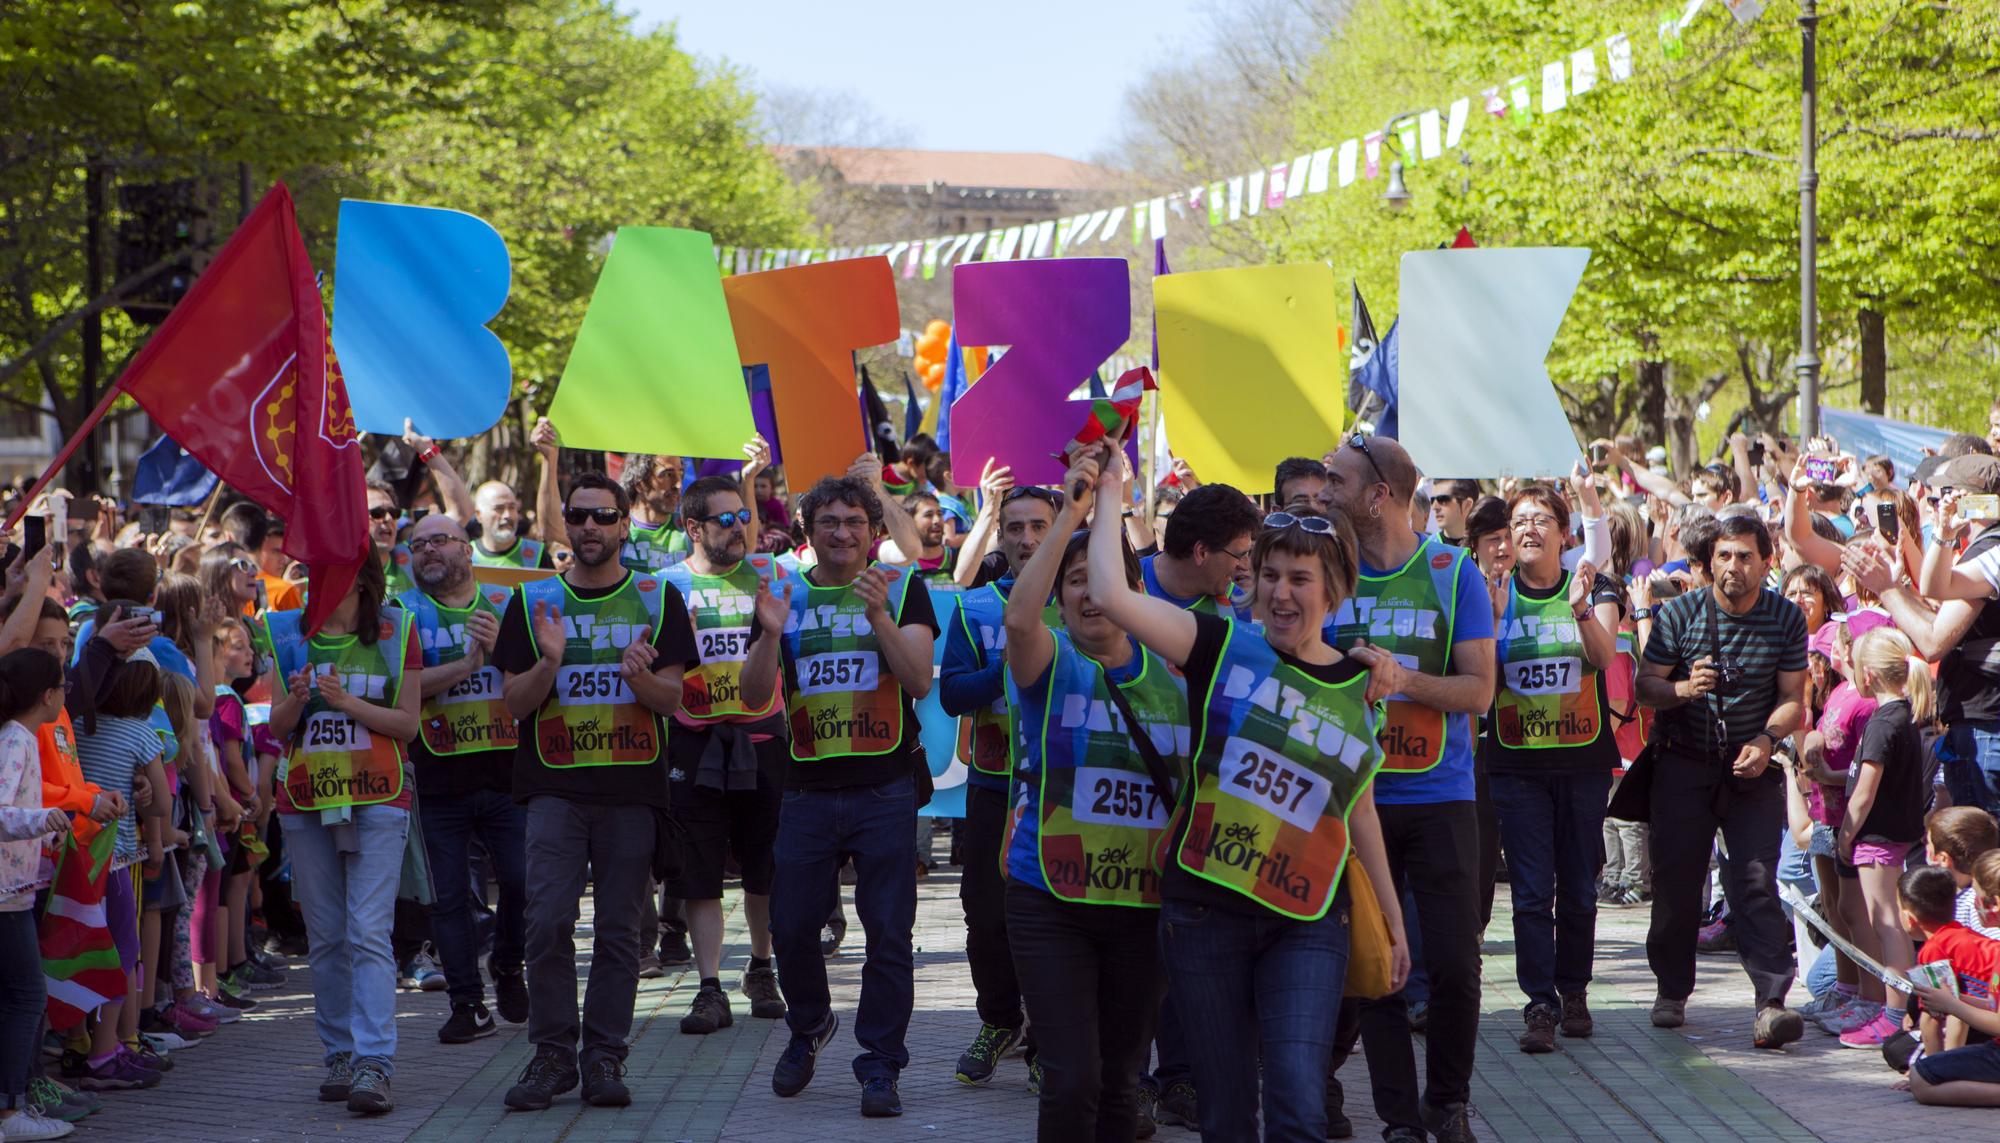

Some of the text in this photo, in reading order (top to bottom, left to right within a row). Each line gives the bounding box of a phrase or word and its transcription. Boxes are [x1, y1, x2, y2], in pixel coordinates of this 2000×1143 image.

[681, 588, 721, 610] AT
[718, 595, 756, 616] ZU
[546, 614, 596, 638] AT
[831, 613, 877, 637] ZU
[1369, 609, 1439, 639] ZUK
[1537, 621, 1583, 645] ZU
[702, 633, 750, 658] 2557
[568, 671, 625, 698] 2557
[715, 671, 731, 688] aek
[808, 658, 865, 687] 2557
[1518, 662, 1571, 690] 2557
[1222, 663, 1307, 721] BAT
[458, 712, 480, 727] aek
[577, 715, 602, 733] aek
[817, 703, 840, 722] aek
[1526, 706, 1549, 721] aek
[310, 719, 357, 746] 2557
[1287, 708, 1370, 774] ZUK
[317, 763, 340, 779] aek
[1231, 751, 1314, 814] 2557
[1091, 777, 1160, 821] 2557
[1225, 822, 1261, 846] aek
[1098, 843, 1132, 866] aek
[1049, 852, 1161, 891] 20.korr
